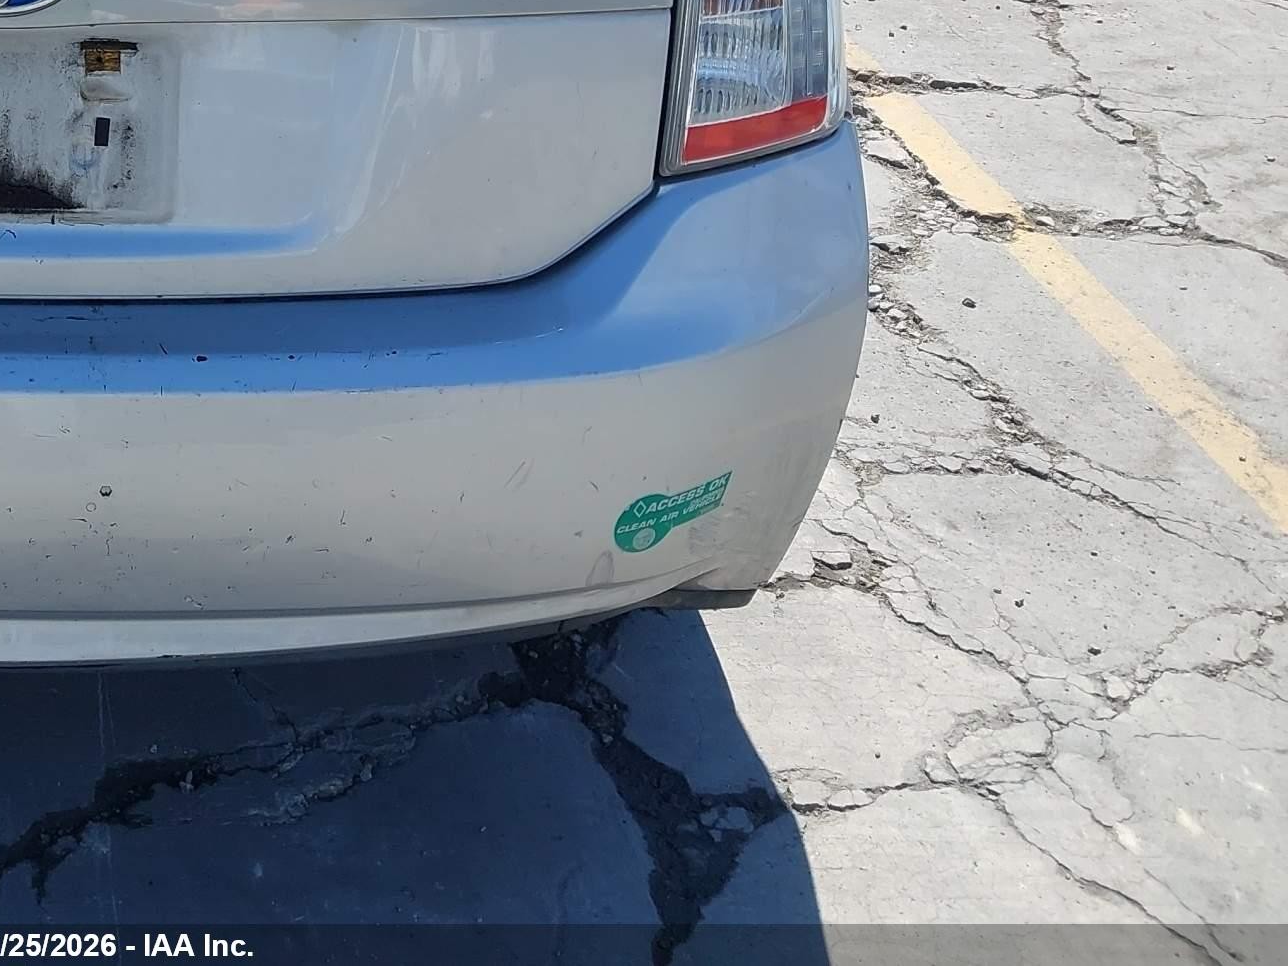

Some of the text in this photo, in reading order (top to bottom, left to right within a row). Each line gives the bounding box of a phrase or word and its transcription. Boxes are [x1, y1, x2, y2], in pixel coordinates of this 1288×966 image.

[645, 474, 729, 514] ACCESS OK
[616, 518, 657, 534] CLEAN
[660, 511, 680, 523] AIR
